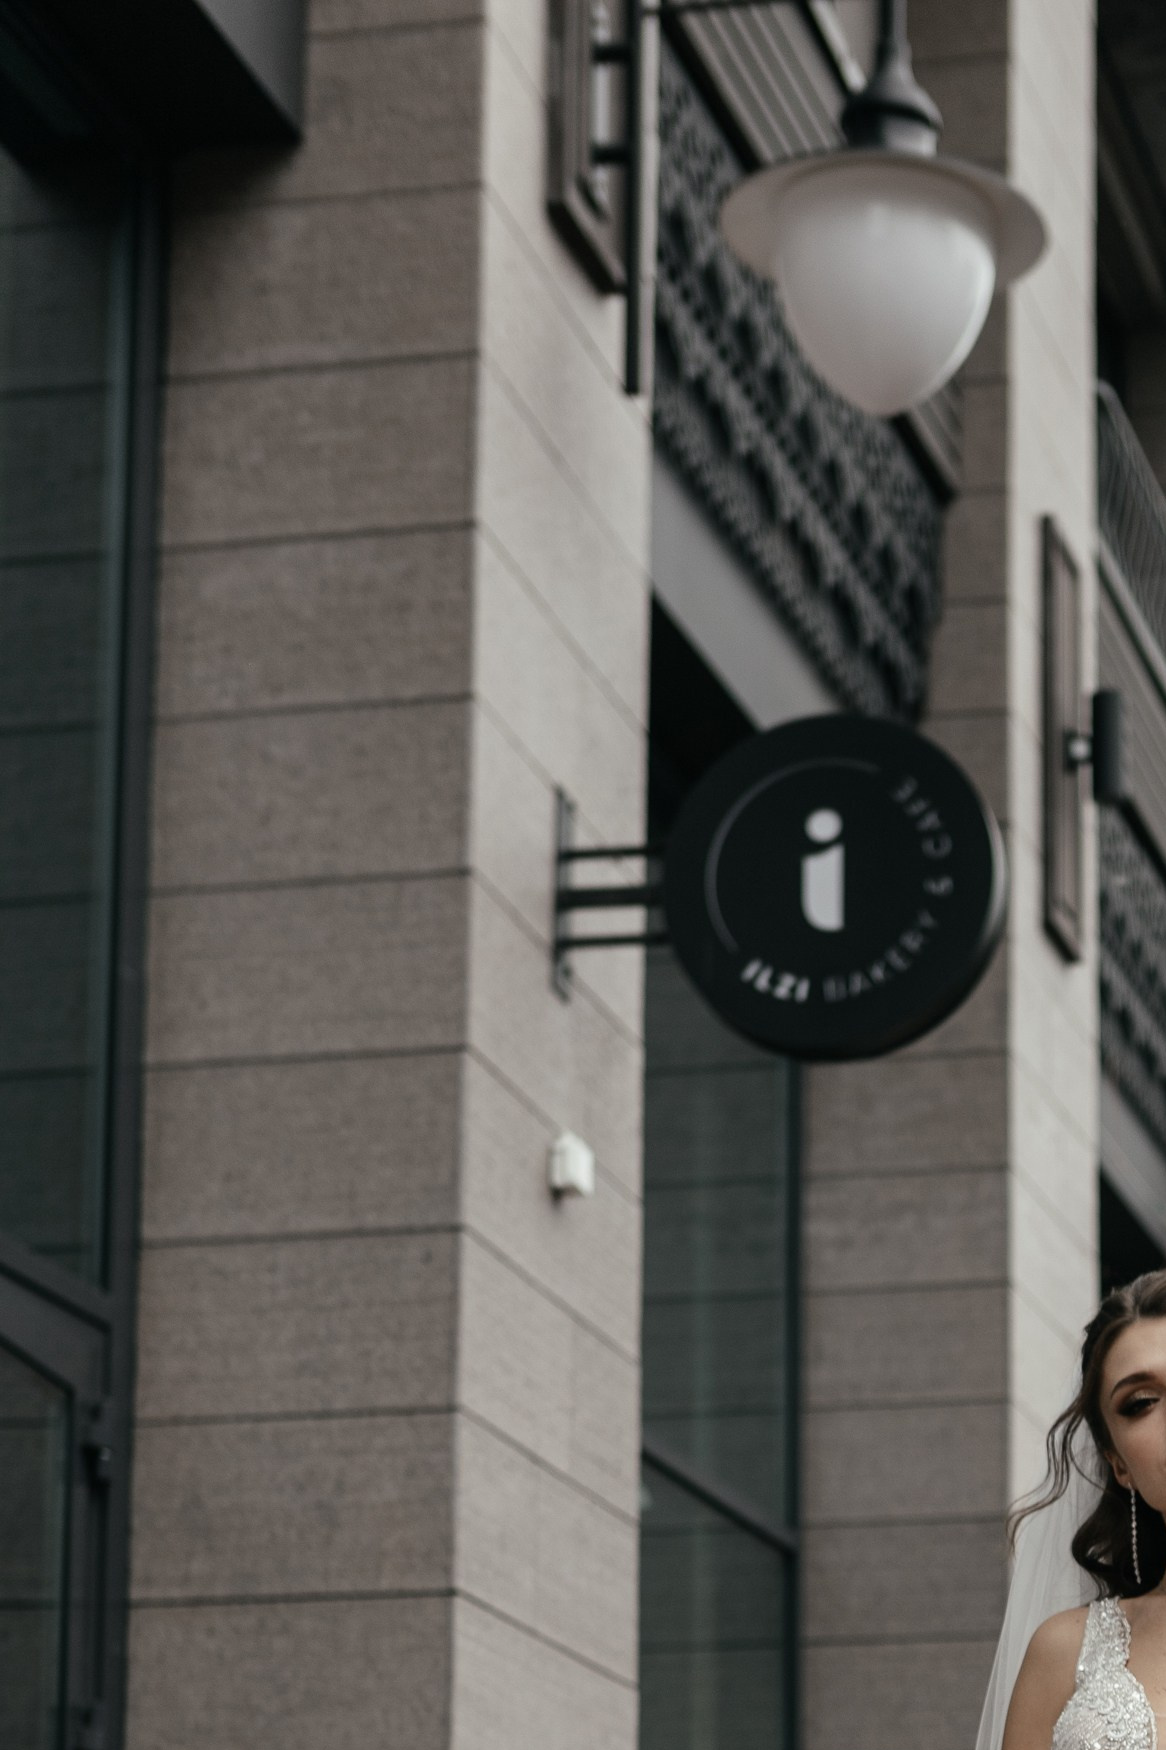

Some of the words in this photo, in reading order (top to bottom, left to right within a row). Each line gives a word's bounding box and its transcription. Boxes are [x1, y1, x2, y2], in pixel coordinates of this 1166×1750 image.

[740, 957, 810, 1003] ILZI
[821, 908, 937, 1002] BAKERY
[893, 776, 953, 859] CAFE
